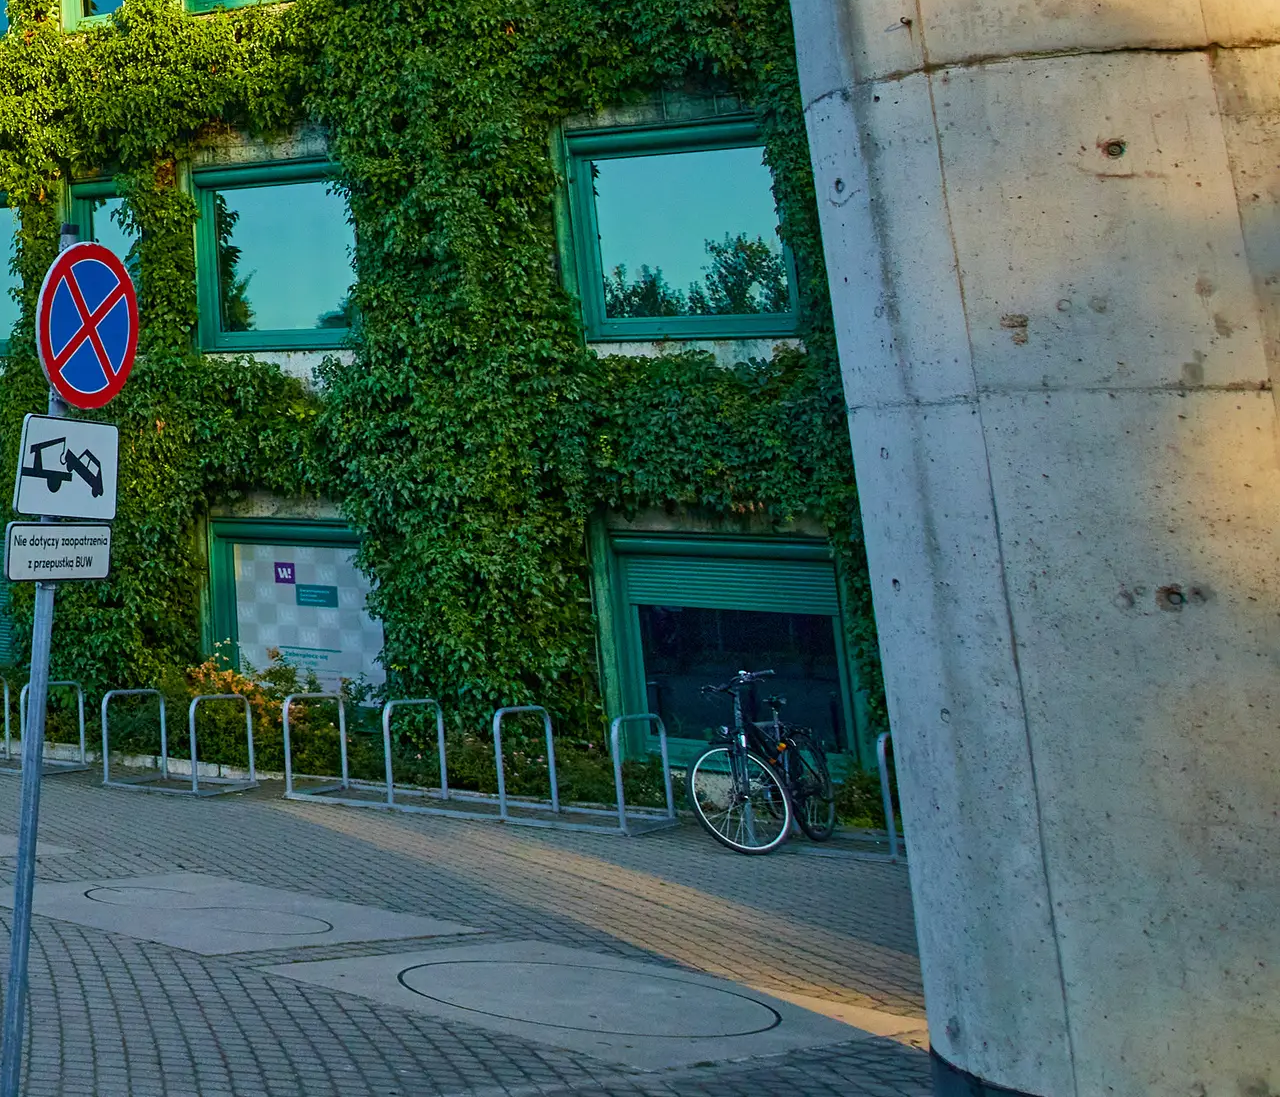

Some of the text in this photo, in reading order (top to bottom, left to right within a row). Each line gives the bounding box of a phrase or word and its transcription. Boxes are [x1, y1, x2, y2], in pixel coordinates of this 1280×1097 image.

[14, 534, 108, 550] Nie dotyczy zaopatrzenia
[28, 555, 93, 571] z przepustką BUW
